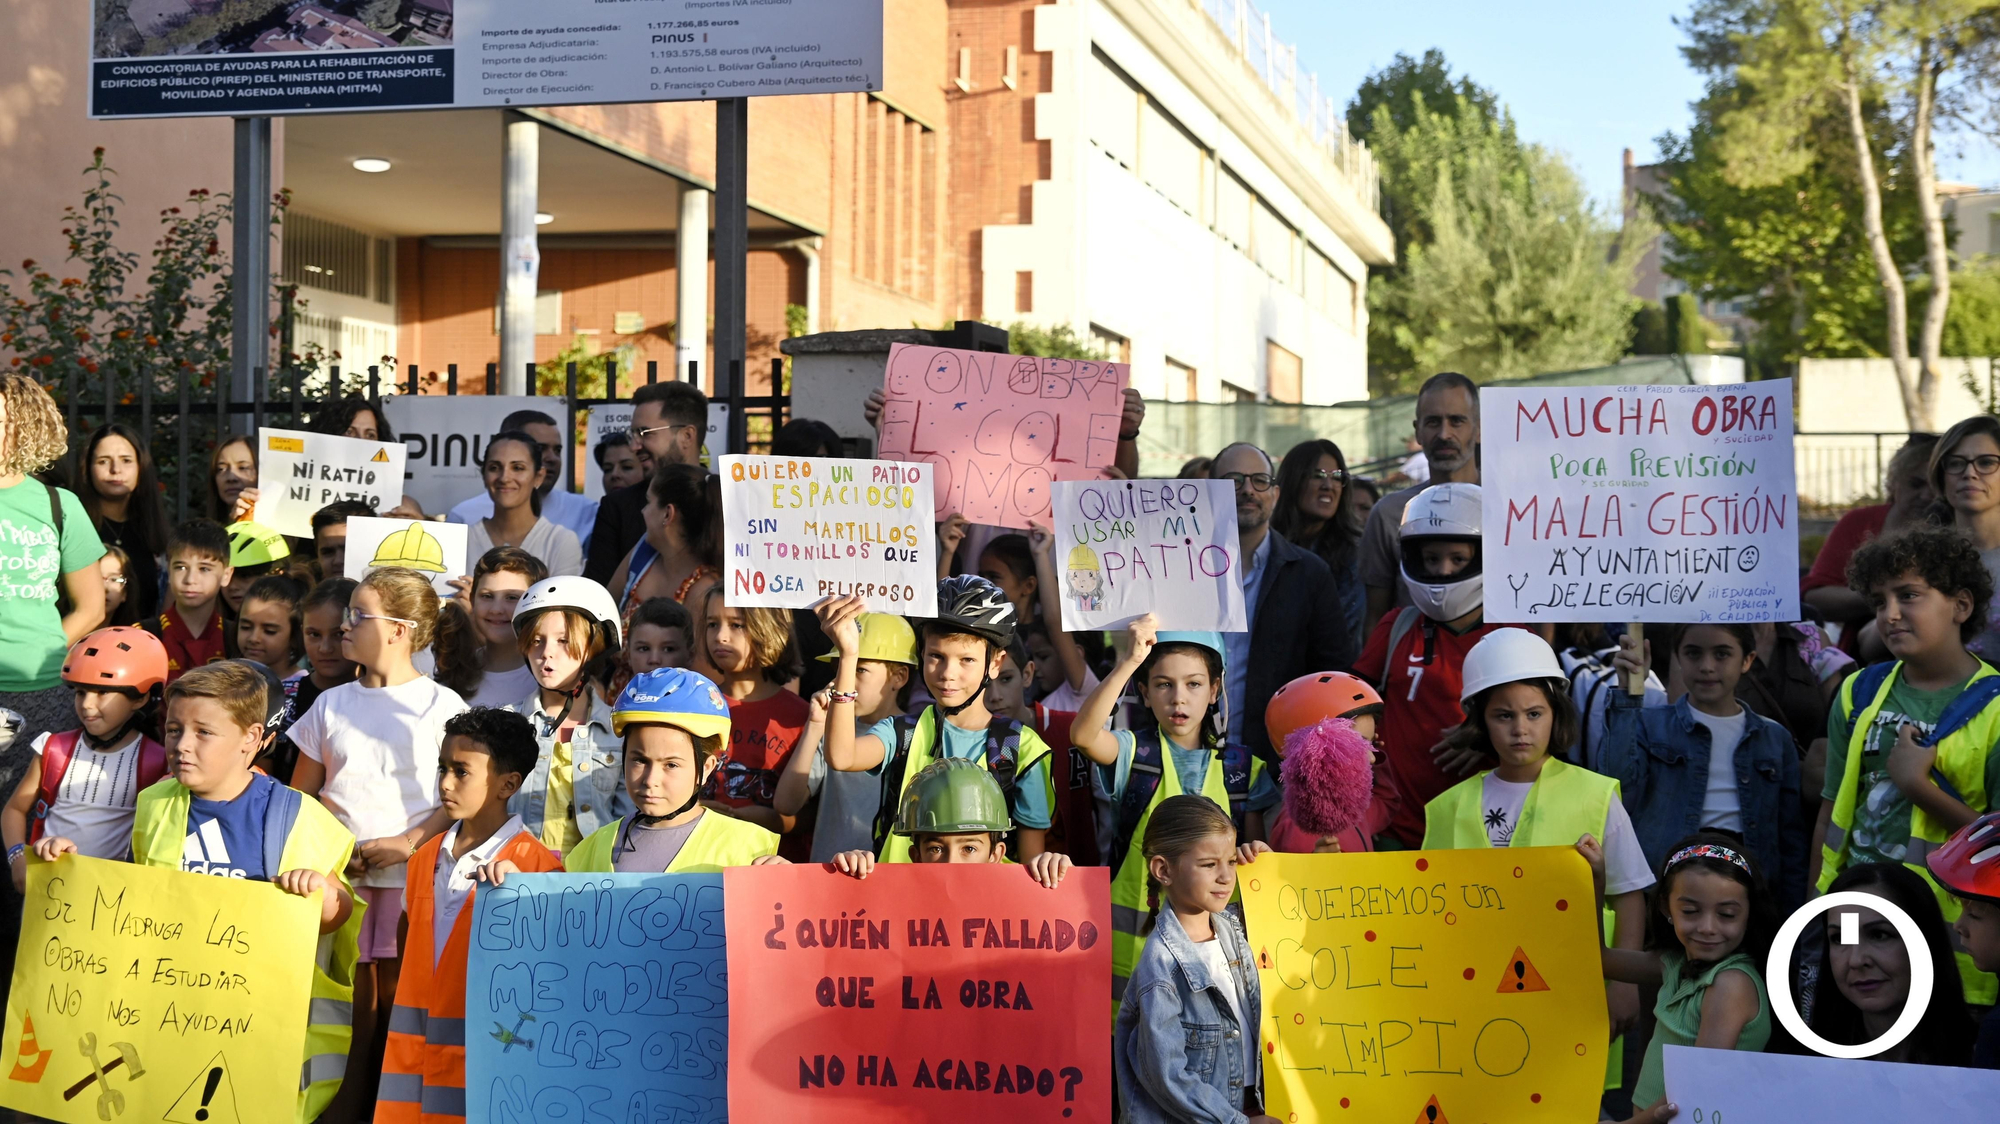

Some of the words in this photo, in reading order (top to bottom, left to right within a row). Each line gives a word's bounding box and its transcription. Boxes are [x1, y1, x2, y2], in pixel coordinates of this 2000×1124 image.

[684, 0, 730, 10] (Importes
[481, 29, 519, 38] Importe
[521, 27, 533, 35] de
[535, 26, 565, 36] ayuda
[567, 24, 621, 34] concedida:
[648, 20, 709, 30] 1.177.266,85
[711, 19, 740, 27] euros
[482, 43, 527, 52] Empresa
[528, 39, 599, 50] Adjudicataria:
[482, 57, 522, 66] Importe
[524, 56, 537, 64] de
[538, 53, 608, 64] adjudicación:
[650, 48, 718, 59] 1.193.575,58
[720, 48, 749, 56] euros
[751, 46, 773, 55] (IVA
[774, 44, 821, 54] incluido)
[101, 78, 158, 89] EDIFICIOS
[159, 76, 210, 86] PÚBLICO
[211, 75, 252, 86] (PIREP)
[254, 74, 276, 84] DEL
[278, 72, 346, 82] MINISTERIO
[348, 71, 364, 80] DE
[365, 68, 447, 79] TRANSPORTE,
[112, 64, 202, 75] CONVOCATORIA
[205, 62, 221, 72] DE
[222, 61, 269, 71] AYUDAS
[271, 58, 301, 69] PARA
[303, 59, 318, 68] LA
[319, 54, 416, 68] REHABILITACIÓN
[418, 54, 435, 64] DE
[482, 70, 522, 80] Director
[524, 70, 538, 78] de
[539, 69, 568, 78] Obra:
[650, 66, 662, 75] D.
[664, 64, 704, 74] Antonio
[706, 64, 716, 72] L.
[718, 62, 754, 72] Bolívar
[756, 60, 798, 70] Galiano
[800, 58, 863, 70] (Arquitecto)
[161, 90, 225, 100] MOVILIDAD
[227, 89, 236, 98] Y
[236, 88, 285, 98] AGENDA
[286, 86, 335, 96] URBANA
[337, 84, 383, 96] (MITMA)
[483, 87, 524, 96] Director
[526, 86, 538, 94] de
[540, 84, 594, 94] Ejecución:
[650, 82, 662, 91] D.
[664, 80, 715, 90] Francisco
[716, 79, 756, 88] Cubero
[758, 77, 782, 87] Alba
[784, 76, 843, 86] (Arquitecto
[846, 74, 870, 84] téc.)
[1646, 384, 1673, 394] PABLO
[604, 414, 615, 423] ES
[1514, 395, 1669, 442] MUCHA
[1692, 395, 1777, 436] OBRA
[879, 399, 938, 456] EL
[974, 408, 1123, 470] COLE
[731, 461, 812, 484] QUIERO
[831, 464, 854, 484] UN
[872, 464, 921, 485] PATIO
[1549, 452, 1608, 480] POCA
[1629, 447, 1756, 480] PREVISIÓN
[772, 482, 915, 510] ESPACIOSO
[1078, 481, 1200, 522] QUIERO
[1503, 493, 1623, 546] MALA
[1646, 486, 1787, 538] GESTIÓN
[747, 518, 778, 536] SIN
[803, 520, 918, 549] MARTILLOS
[1072, 520, 1136, 545] USAR
[734, 542, 750, 558] NI
[764, 541, 871, 562] TORNILLOS
[883, 546, 920, 564] QUE
[1102, 538, 1231, 589] PATIO
[734, 568, 766, 597] NO
[768, 574, 805, 594] SEA
[818, 578, 915, 603] PELIGROSO
[1507, 572, 1530, 610] Y
[1542, 579, 1704, 609] DELEGACIÓN
[1406, 666, 1425, 702] 7
[747, 730, 788, 756] RACE
[1278, 882, 1448, 924] QUEREMOS
[90, 886, 184, 942] MADRUGA
[206, 908, 250, 955] LAS
[477, 884, 550, 952] EN
[764, 902, 891, 951] ¿QUIÉN
[908, 918, 953, 948] HA
[960, 916, 1099, 954] FALLADO
[44, 936, 108, 975] OBRAS
[126, 958, 140, 981] A
[151, 956, 251, 996] ESTUDIAR
[1274, 938, 1428, 991] COLE
[490, 960, 569, 1014] ME
[815, 976, 876, 1010] QUE
[902, 978, 940, 1010] LA
[958, 979, 1034, 1012] OBRA
[46, 981, 83, 1018] NO
[108, 999, 141, 1028] NOS
[798, 1053, 847, 1090] NO
[856, 1054, 901, 1090] HA
[912, 1058, 1084, 1120] ACABADO?
